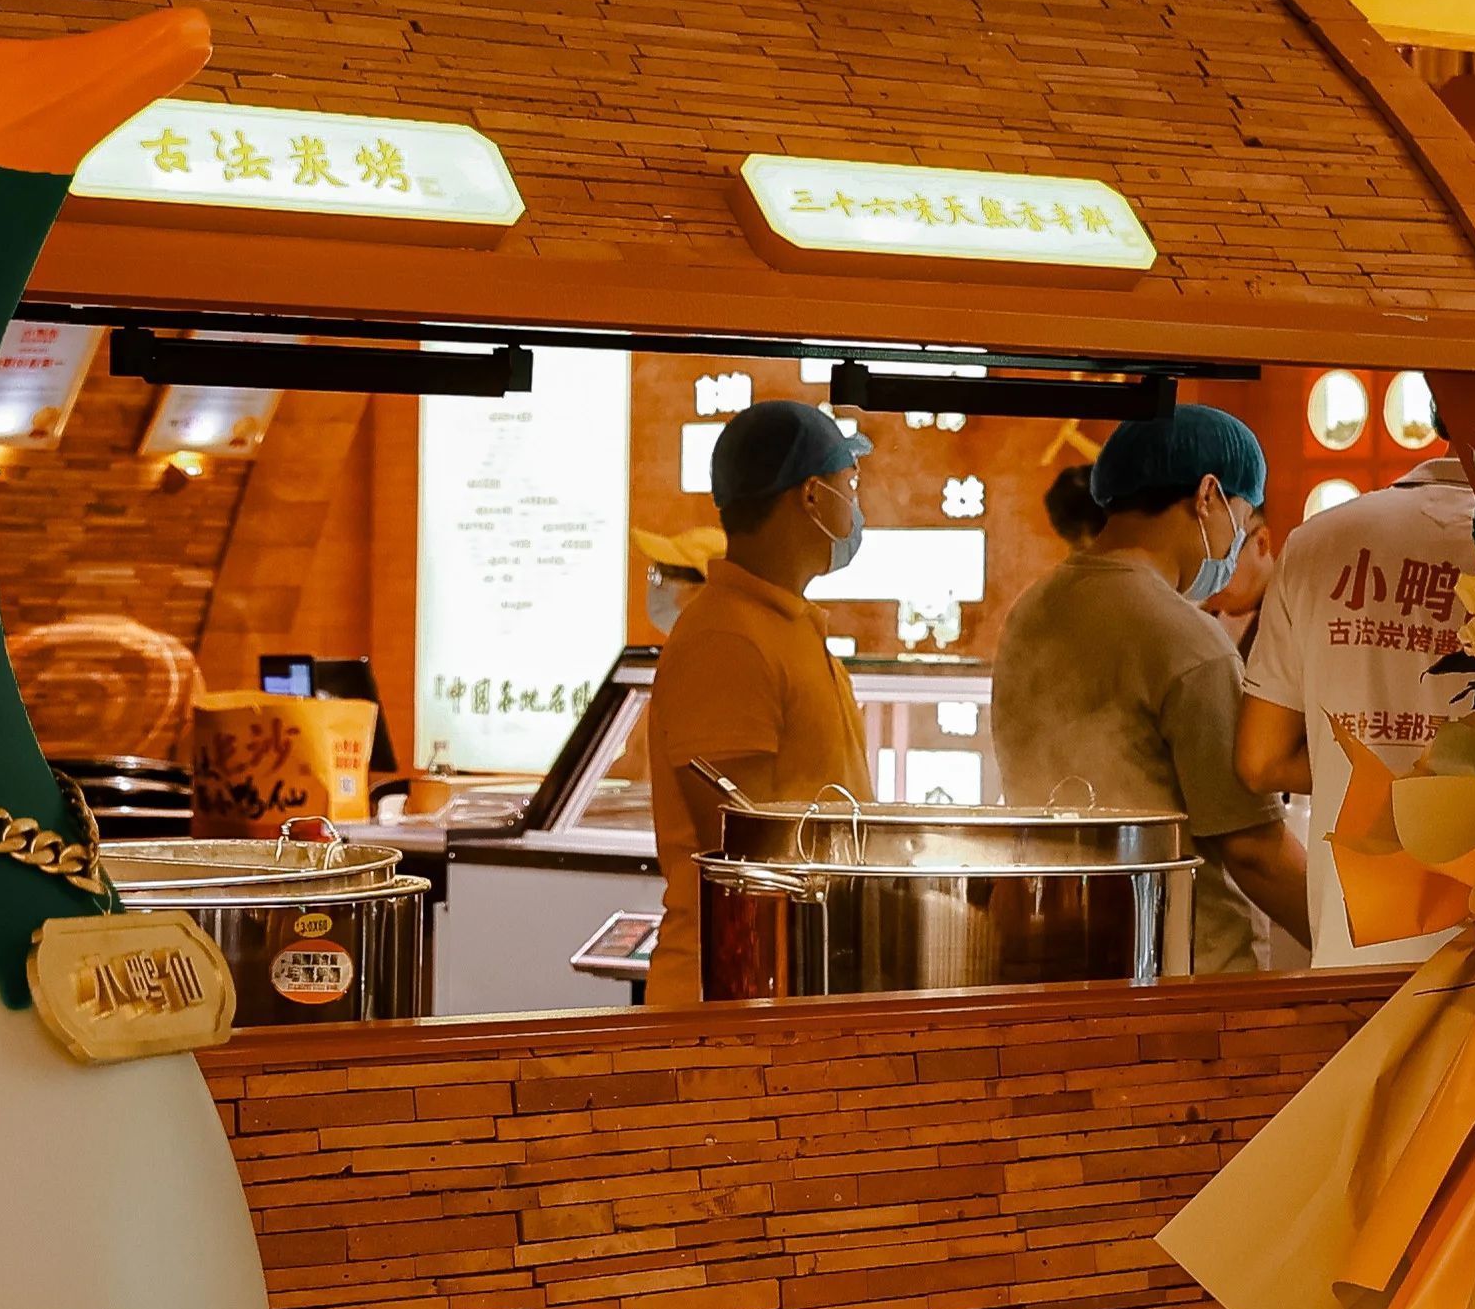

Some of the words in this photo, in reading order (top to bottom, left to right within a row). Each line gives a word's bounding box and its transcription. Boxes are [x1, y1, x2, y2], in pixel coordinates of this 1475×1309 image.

[140, 126, 413, 194] 古法炭烤
[1329, 547, 1470, 623] 小鸭
[77, 948, 204, 1019] 小鸭仙
